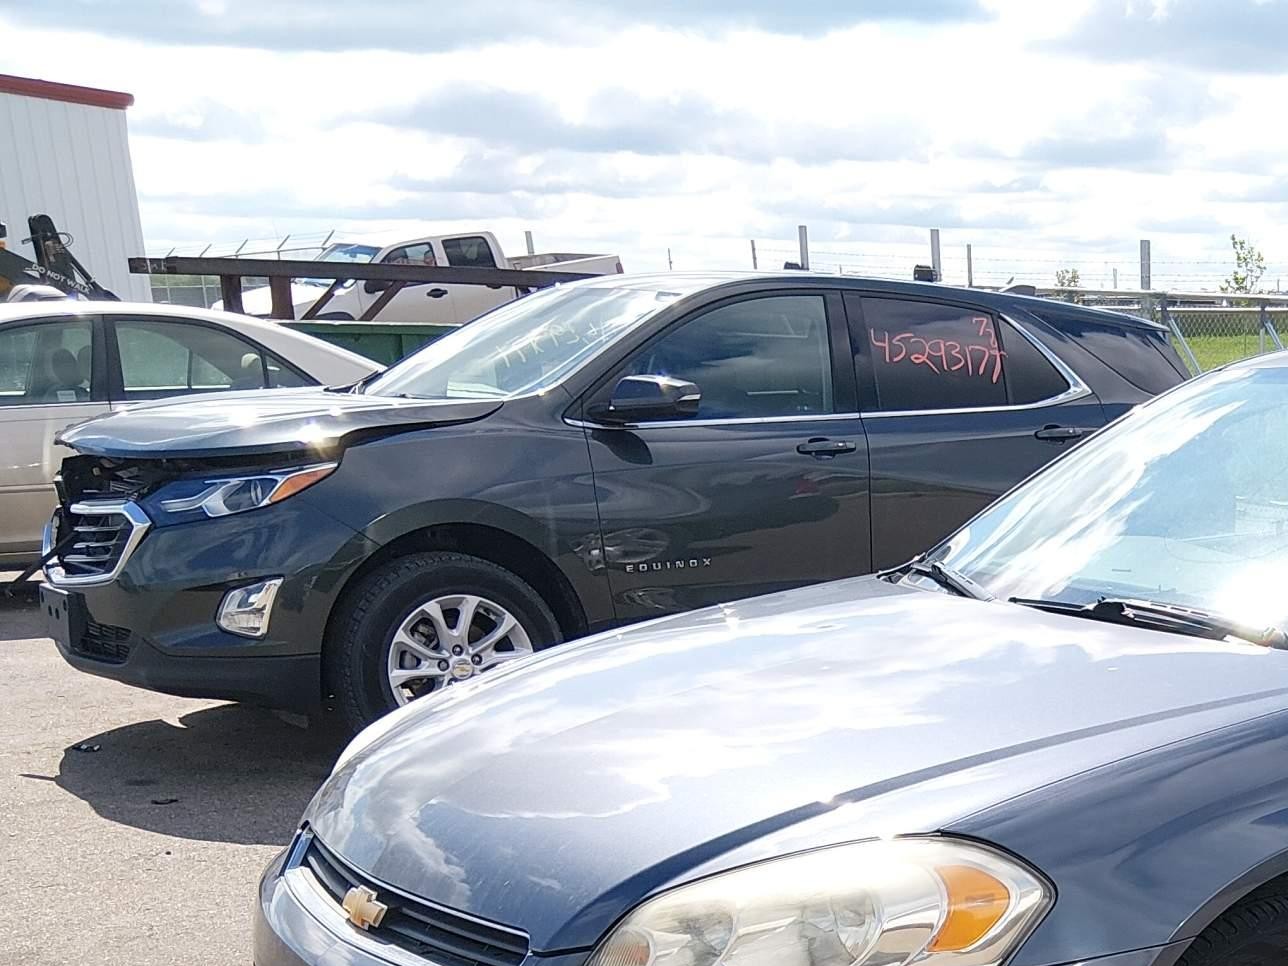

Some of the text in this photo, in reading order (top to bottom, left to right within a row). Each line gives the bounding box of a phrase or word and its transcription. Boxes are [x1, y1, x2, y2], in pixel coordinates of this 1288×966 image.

[31, 263, 90, 295] DO NOT WALK
[625, 558, 712, 573] EQUINOX
